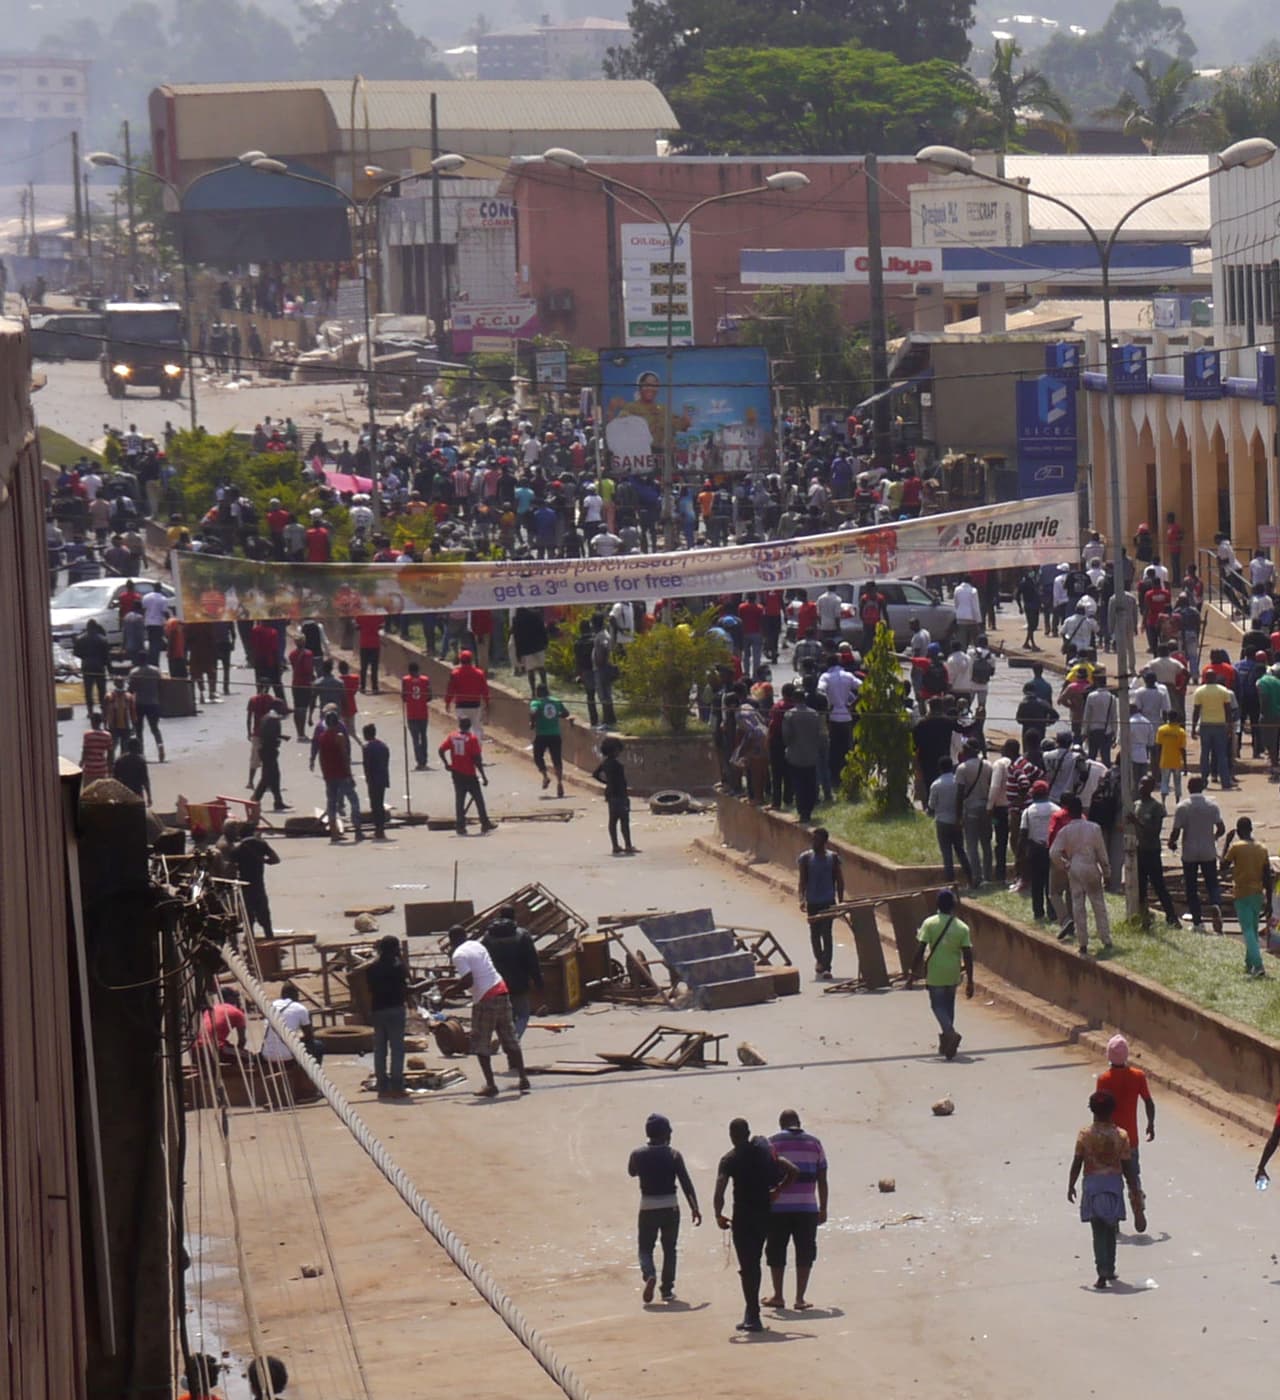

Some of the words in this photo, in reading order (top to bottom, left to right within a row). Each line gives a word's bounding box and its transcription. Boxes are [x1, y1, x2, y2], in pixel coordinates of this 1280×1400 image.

[964, 516, 1060, 546] Seigneurie
[493, 582, 524, 602] get
[529, 584, 542, 597] a
[546, 579, 568, 596] 3rd
[574, 579, 610, 594] one
[614, 575, 640, 591] for
[645, 572, 682, 590] free
